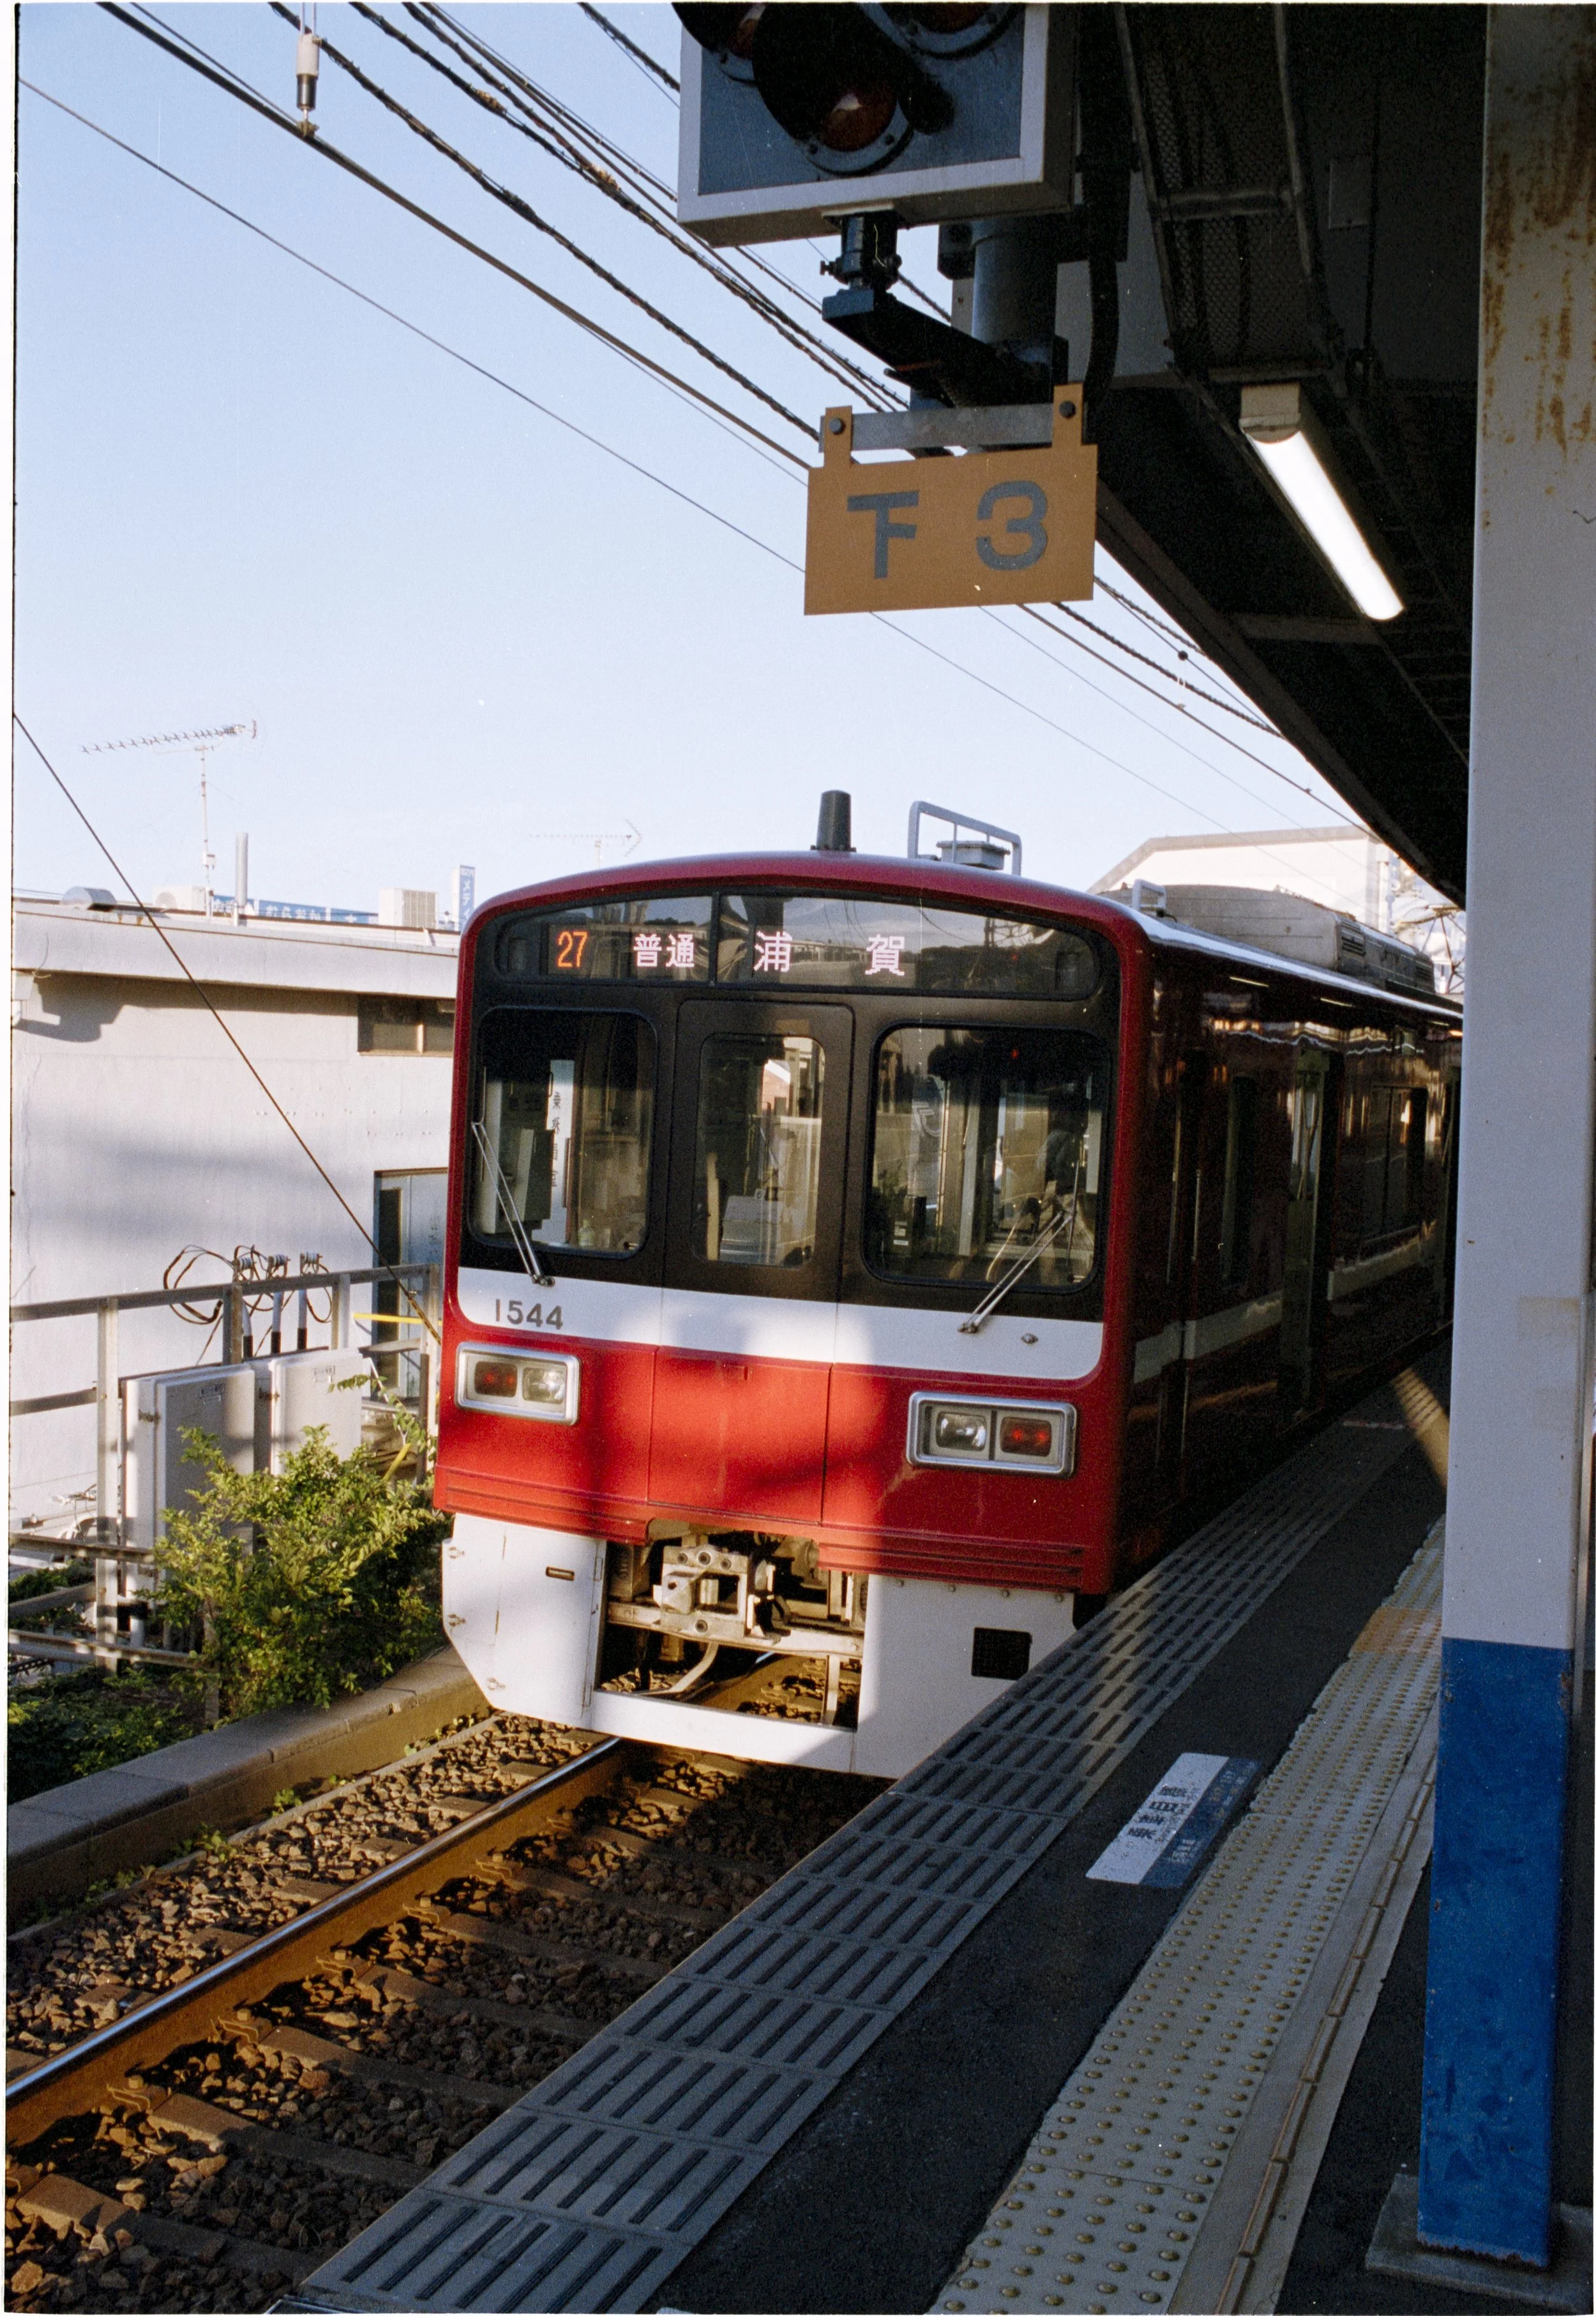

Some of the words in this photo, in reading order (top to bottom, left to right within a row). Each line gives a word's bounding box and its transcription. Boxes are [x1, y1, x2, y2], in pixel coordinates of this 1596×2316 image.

[847, 490, 919, 578] 下
[976, 480, 1048, 570] 3
[557, 931, 588, 968] 27
[633, 933, 695, 968] 普通
[753, 931, 905, 976] 浦賀
[495, 1298, 564, 1330] 1544
